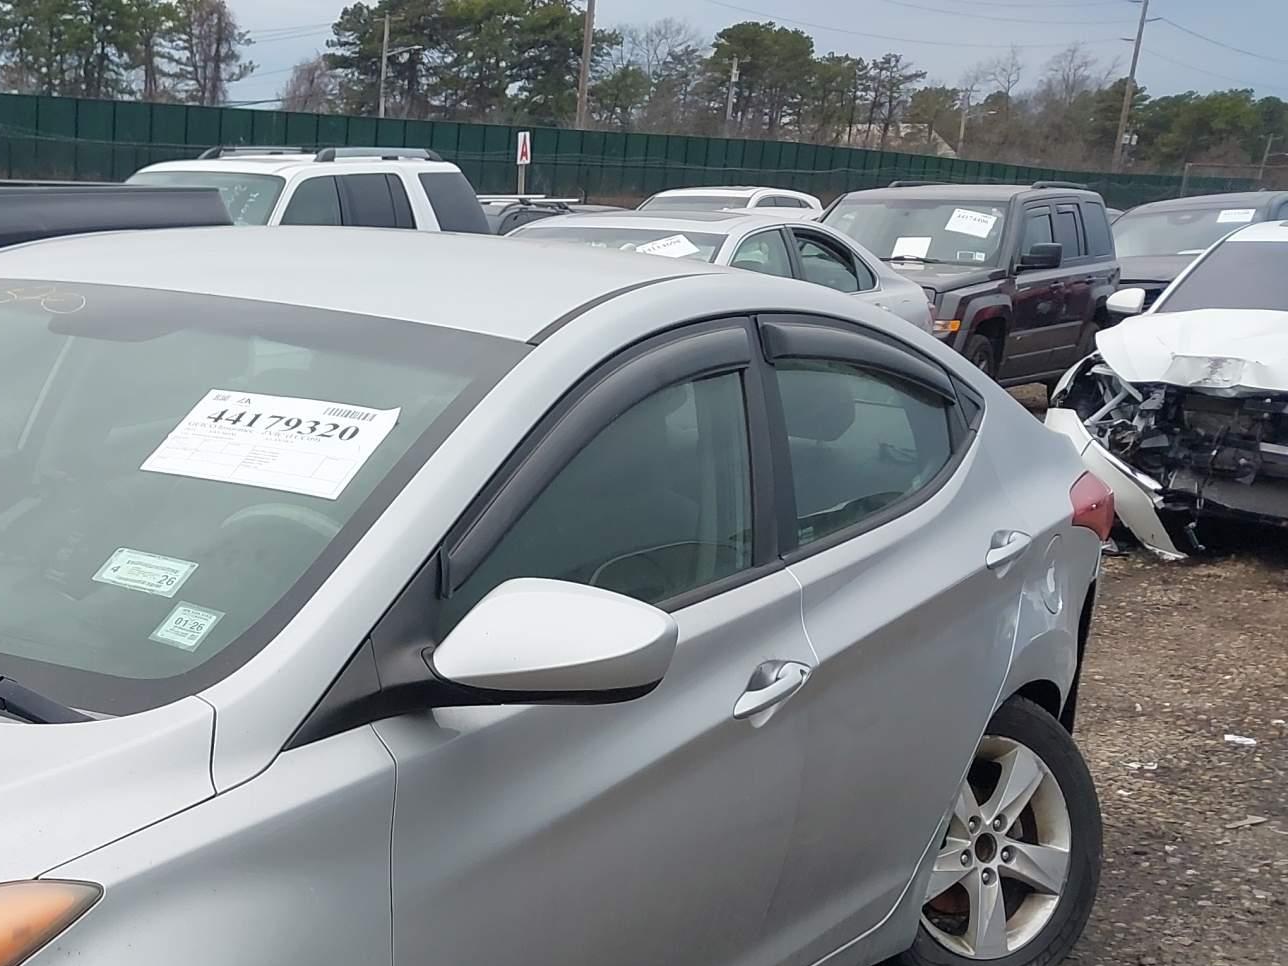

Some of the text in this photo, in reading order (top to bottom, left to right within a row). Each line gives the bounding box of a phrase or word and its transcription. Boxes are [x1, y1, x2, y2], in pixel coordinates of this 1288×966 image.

[520, 133, 528, 161] A
[207, 409, 360, 441] 44179320
[111, 565, 121, 573] 4
[158, 574, 177, 586] 26
